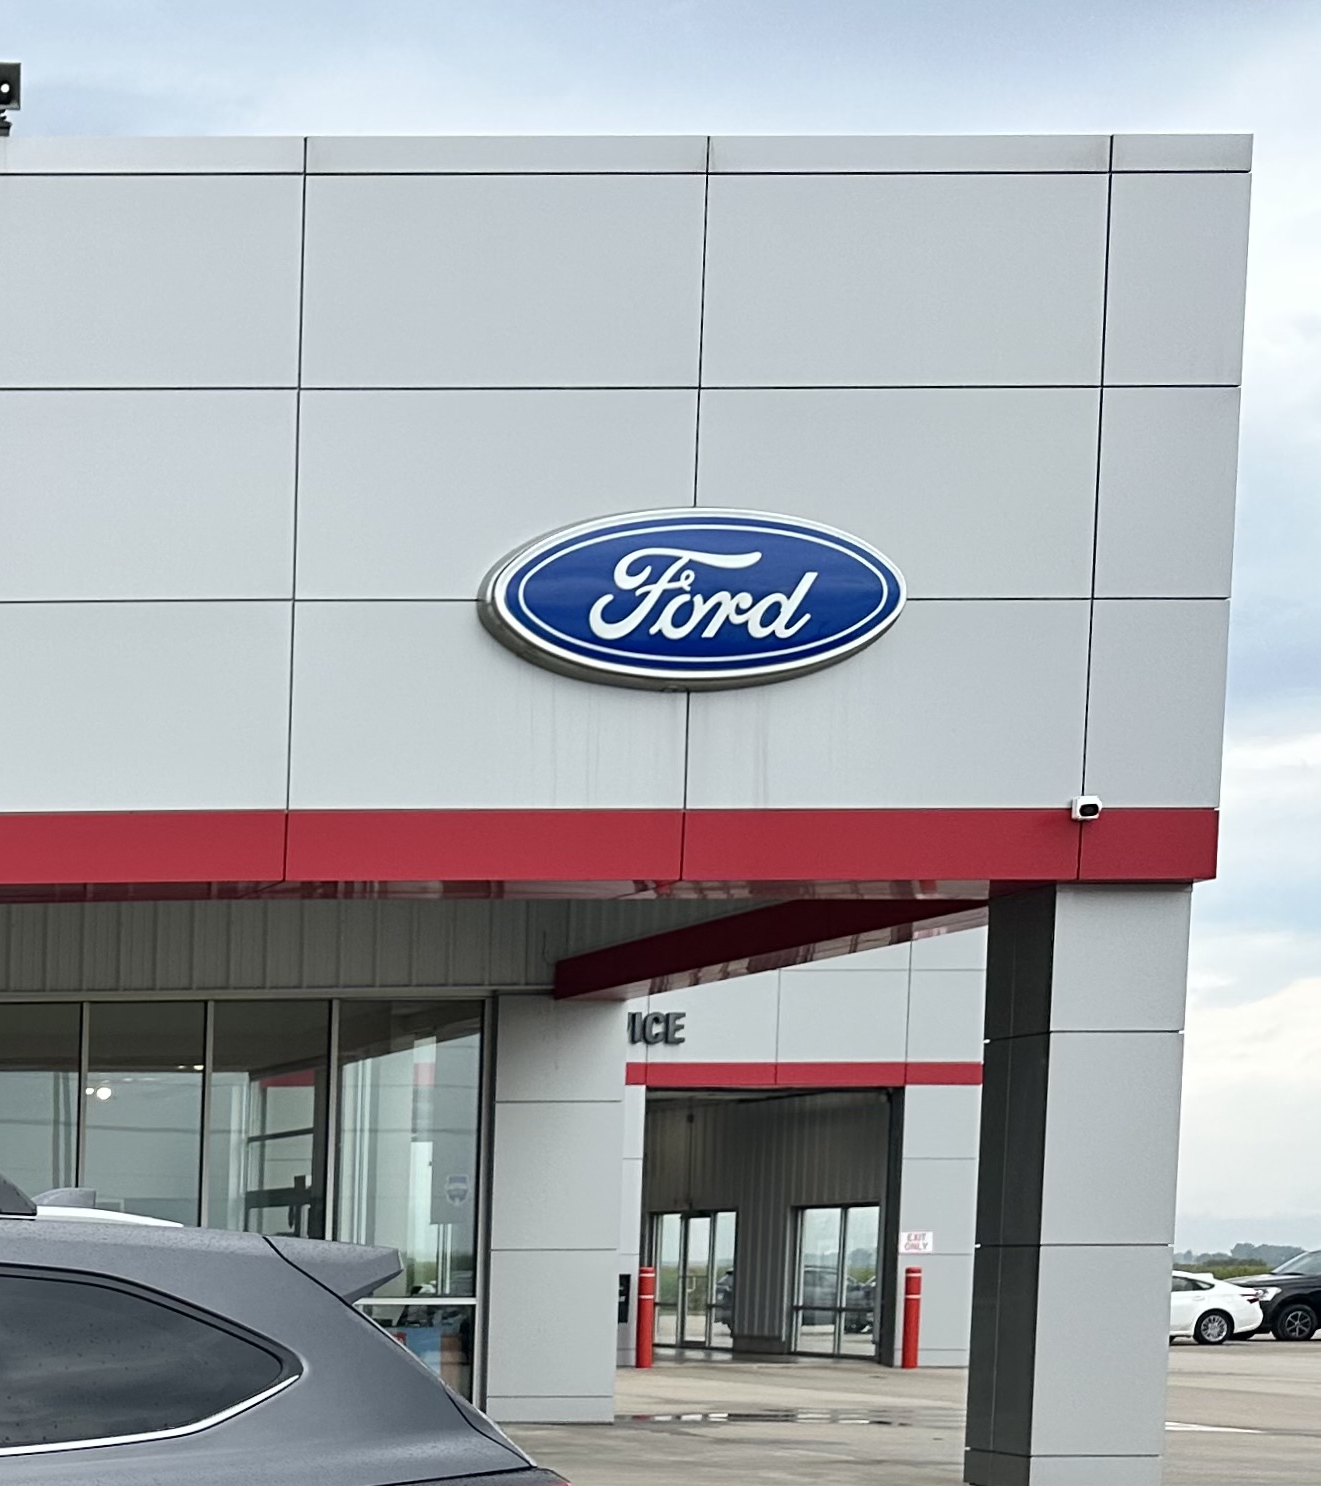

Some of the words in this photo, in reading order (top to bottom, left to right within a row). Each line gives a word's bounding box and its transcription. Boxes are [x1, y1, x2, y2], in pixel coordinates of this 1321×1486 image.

[588, 546, 819, 641] Ford
[627, 1011, 686, 1045] ICE
[904, 1242, 929, 1251] ONLY
[906, 1232, 927, 1242] EXIT
